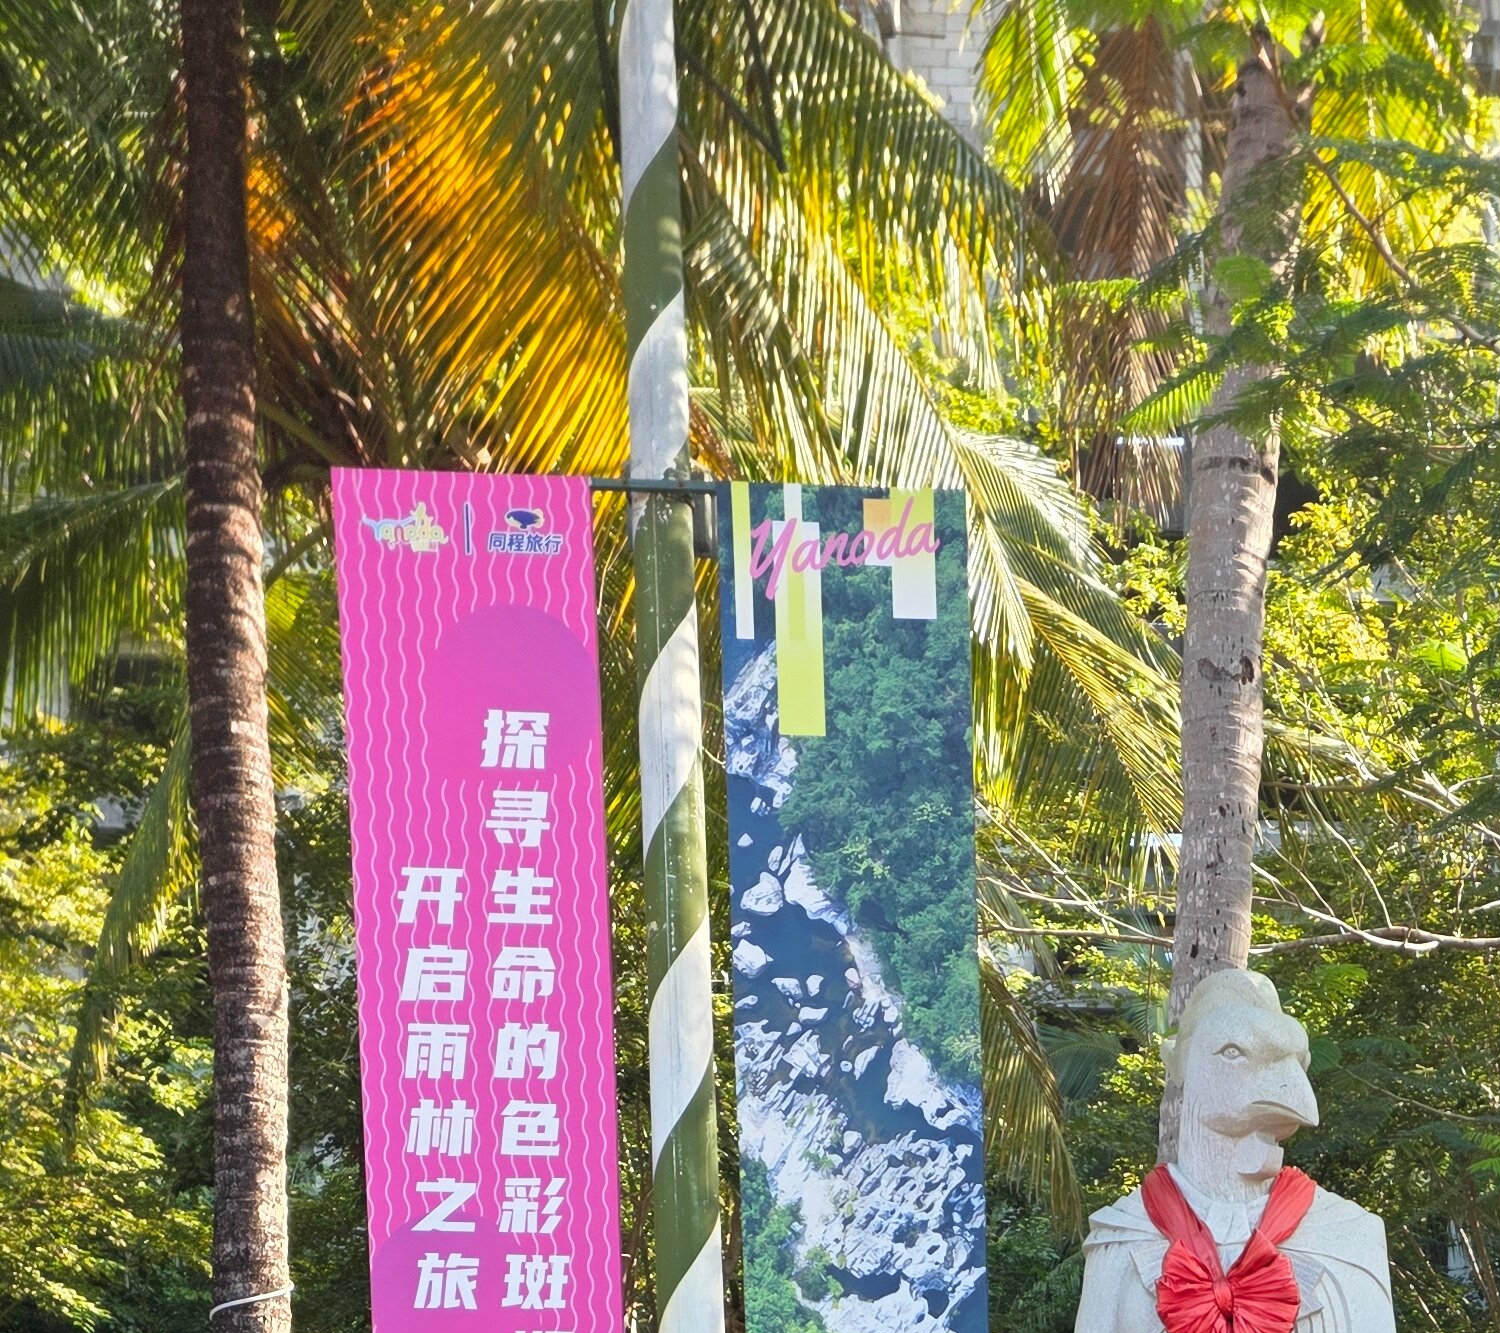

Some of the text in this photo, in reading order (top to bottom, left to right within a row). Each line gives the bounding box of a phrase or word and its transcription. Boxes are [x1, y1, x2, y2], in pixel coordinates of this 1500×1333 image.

[488, 532, 562, 554] 同程旅行
[750, 496, 940, 600] Yanoda
[397, 866, 479, 1310] 开启雨林之旅
